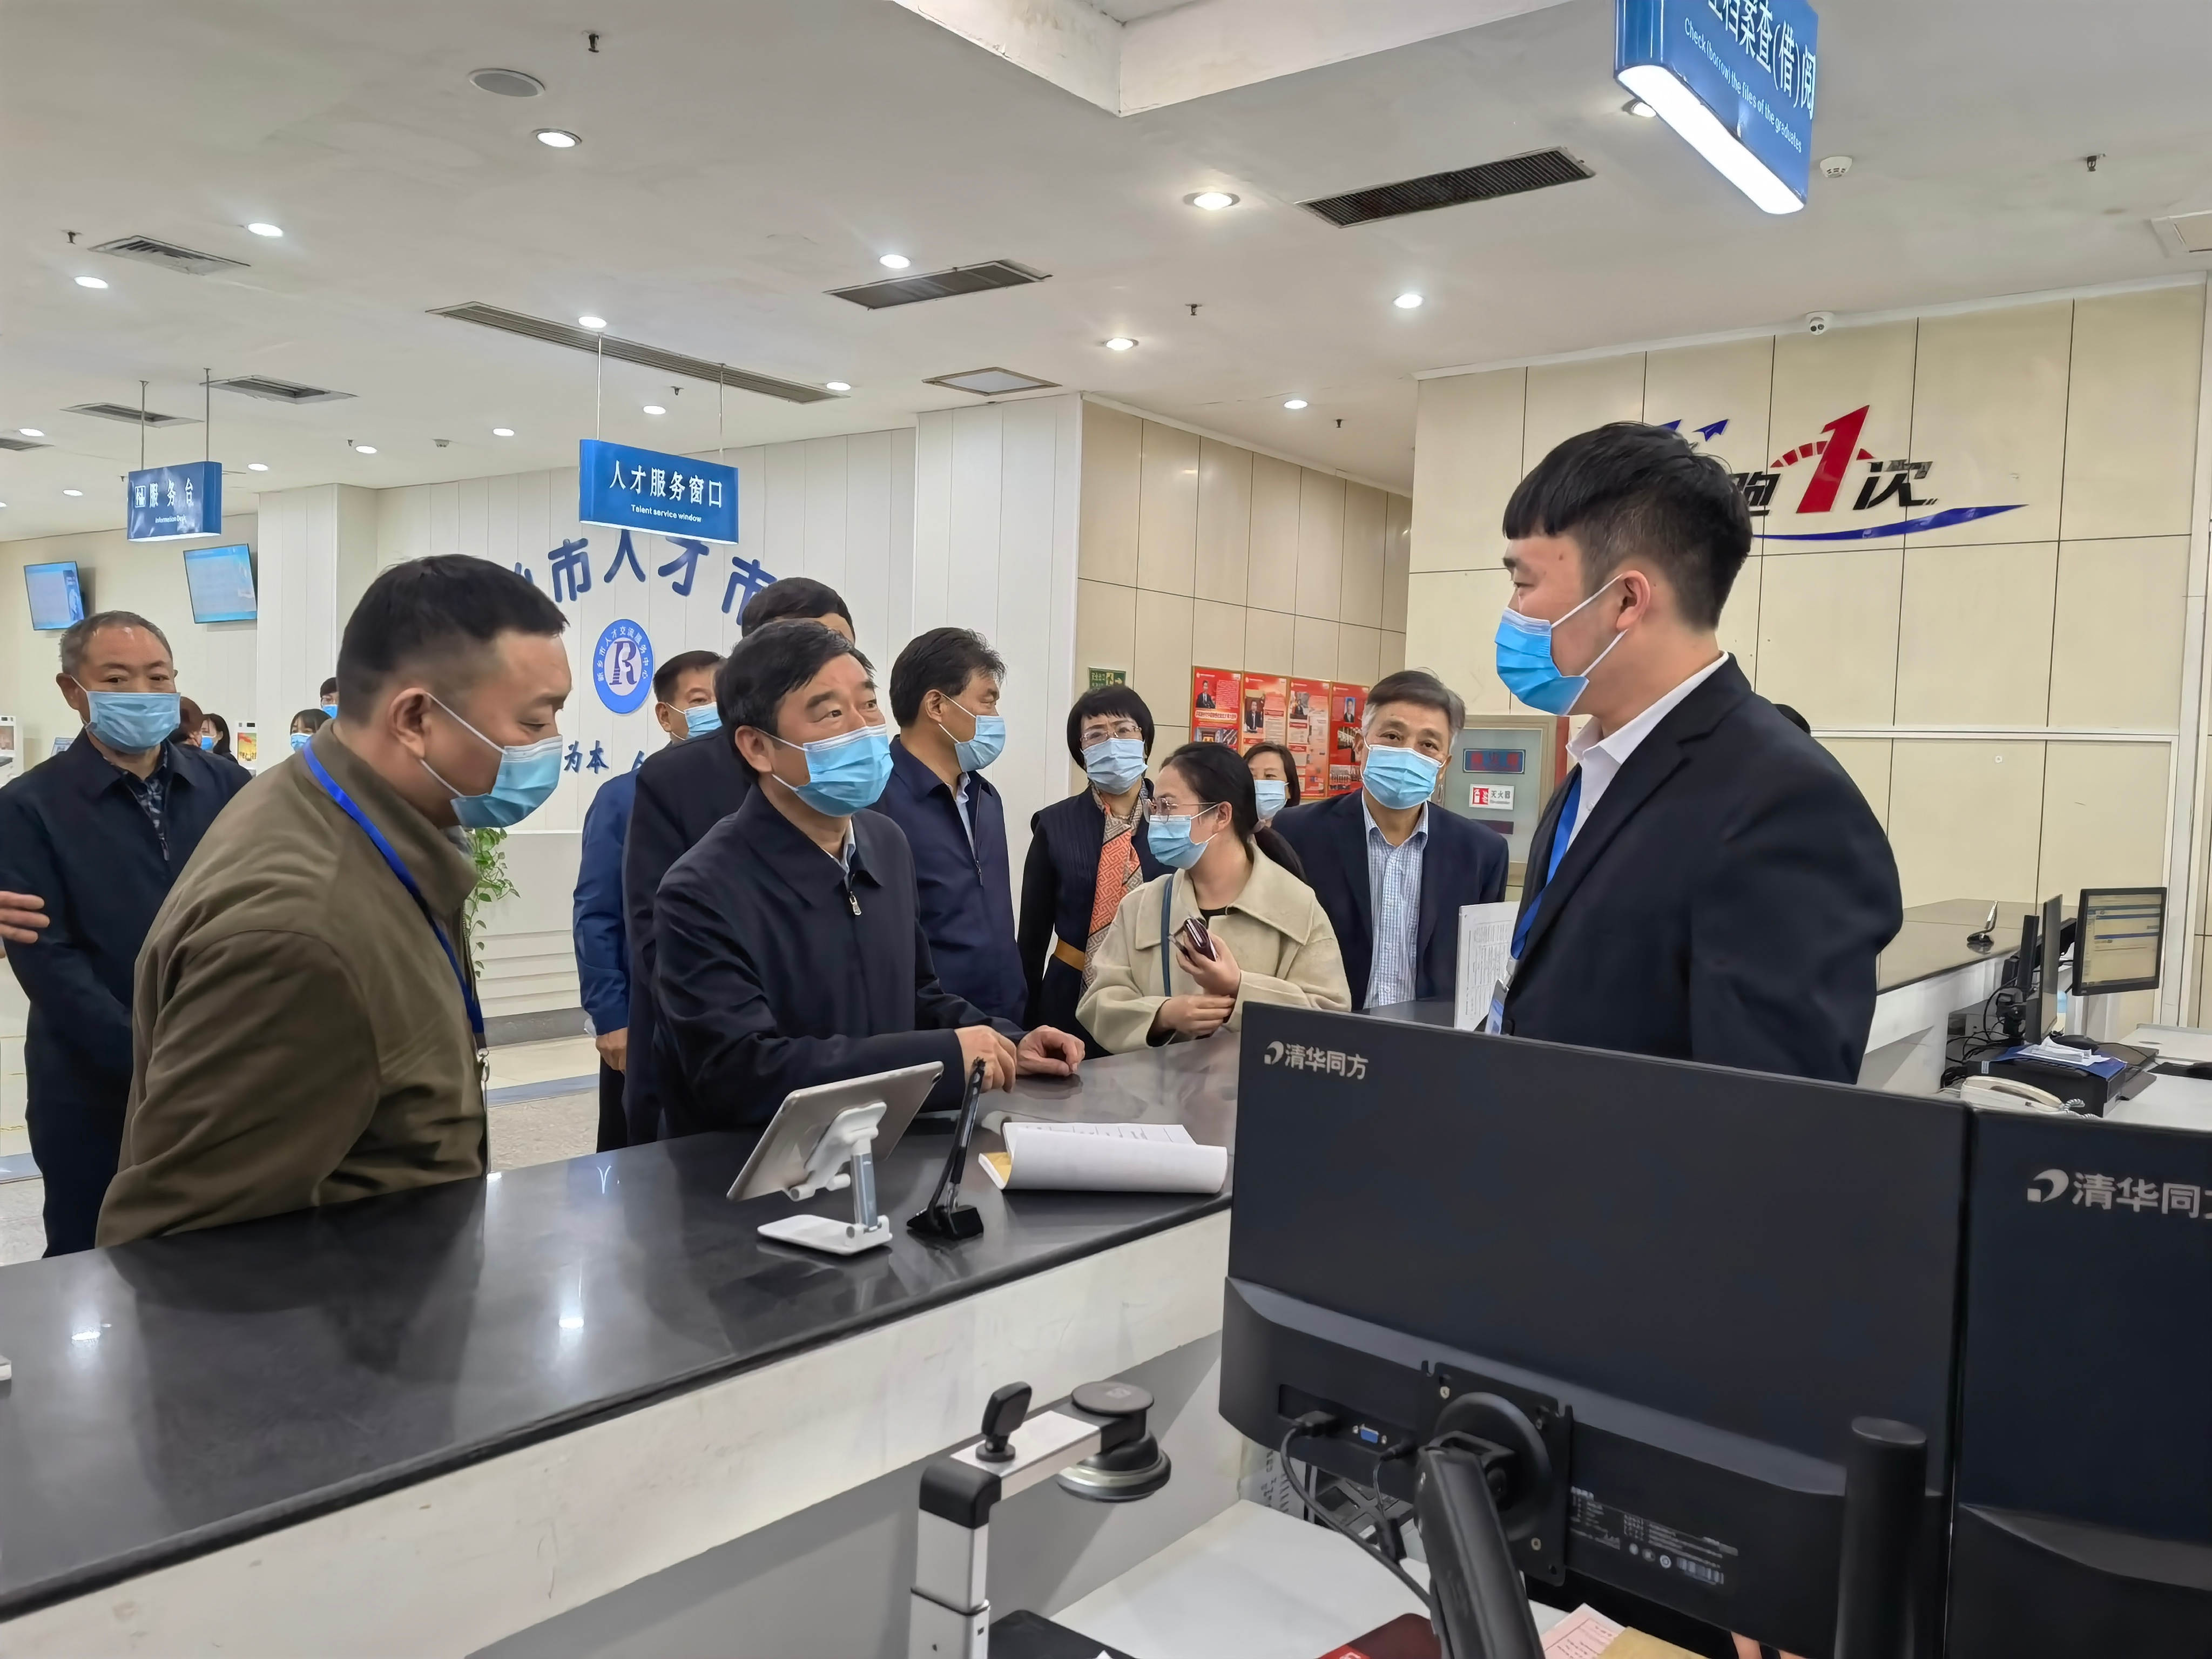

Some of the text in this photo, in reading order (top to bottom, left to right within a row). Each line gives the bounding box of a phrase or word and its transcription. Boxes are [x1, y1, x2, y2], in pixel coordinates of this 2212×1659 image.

[1684, 17, 1802, 153] Check (borrow) the files of the graduates
[150, 477, 194, 508] 服务台
[609, 460, 722, 508] 人才服务窗口
[631, 504, 702, 523] Talent service window
[514, 529, 778, 625] 市人才市
[1285, 1043, 1369, 1080] 清华同方
